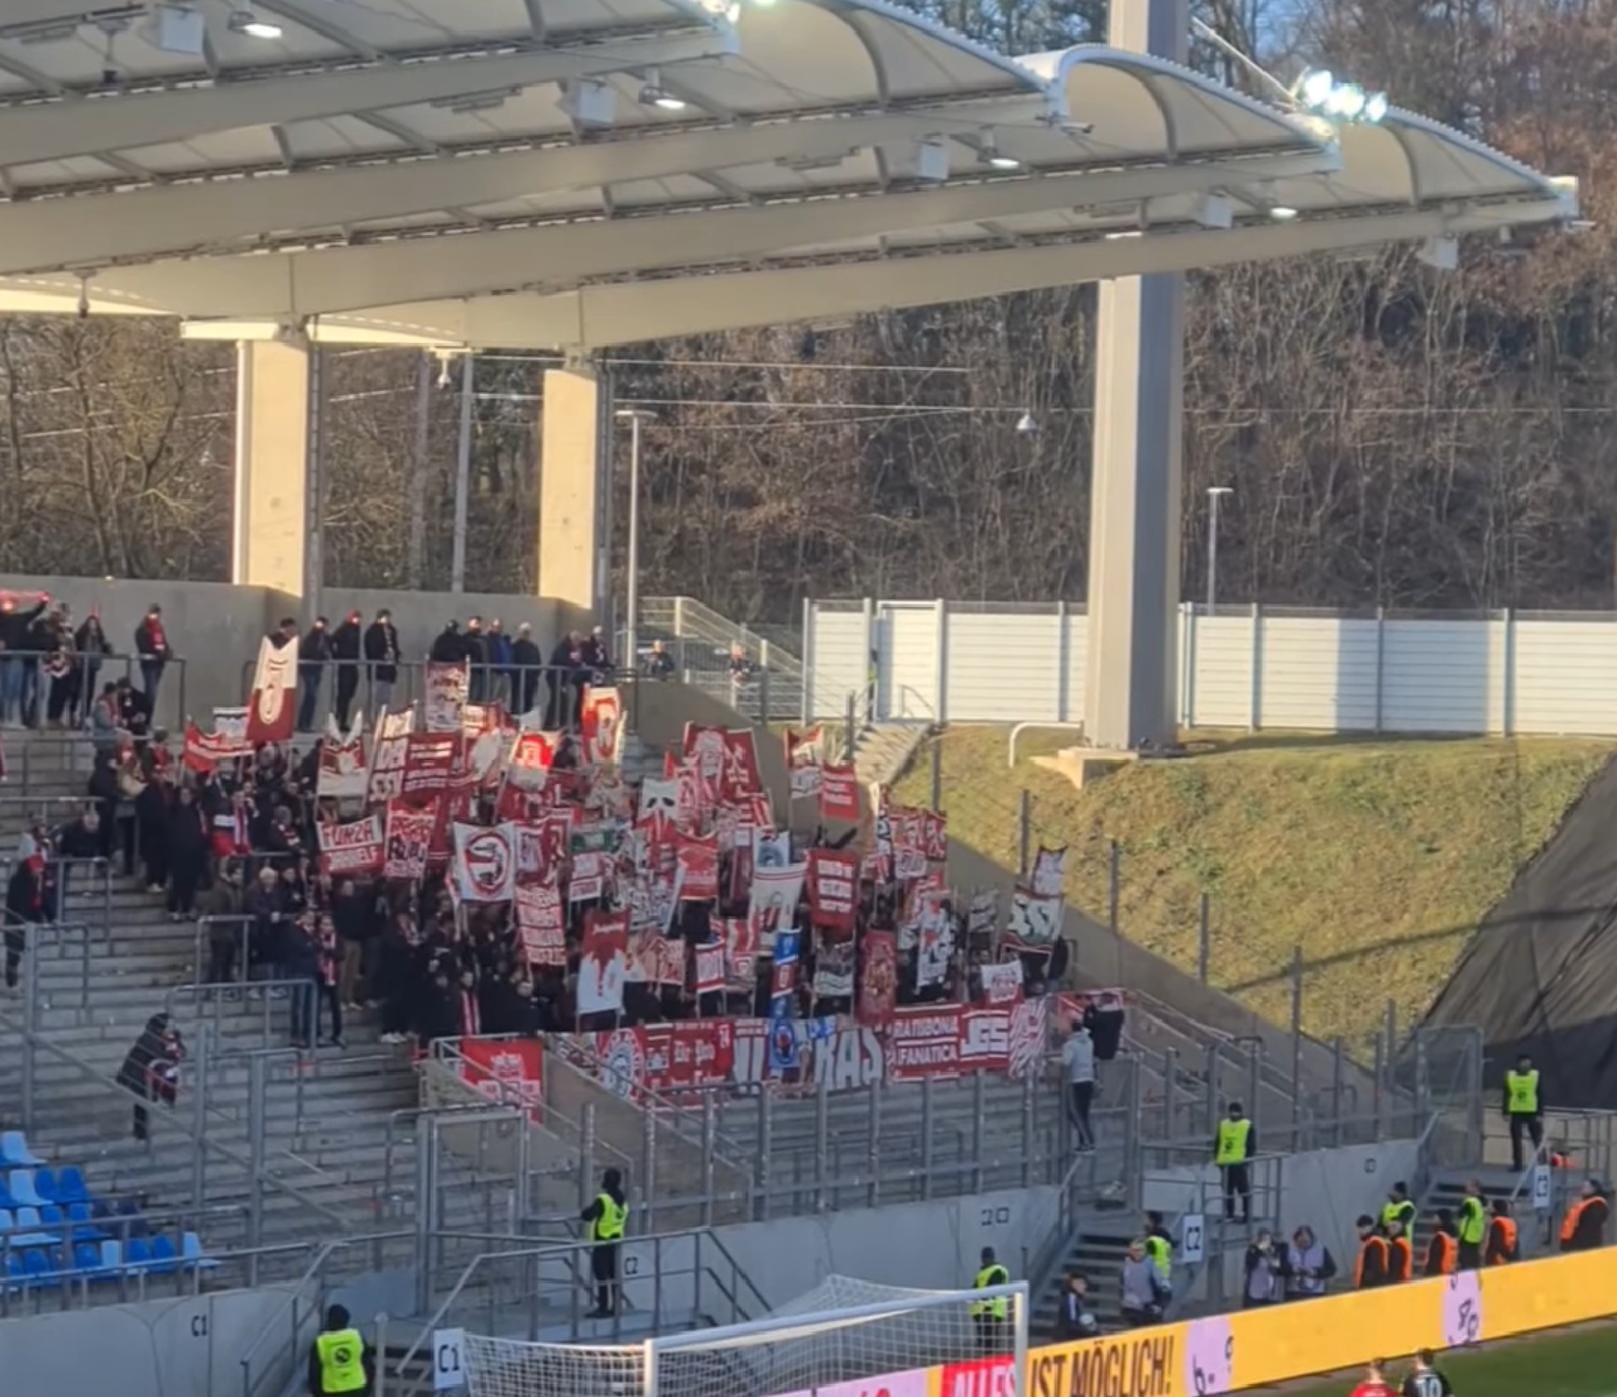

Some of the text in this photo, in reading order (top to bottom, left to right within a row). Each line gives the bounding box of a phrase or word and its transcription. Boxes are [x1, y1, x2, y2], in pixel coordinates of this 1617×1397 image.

[1186, 1226, 1201, 1251] C2
[191, 1315, 208, 1337] C1
[438, 1344, 460, 1373] C1
[1030, 1354, 1068, 1397] IST
[1071, 1335, 1175, 1397] MÖGLICH!
